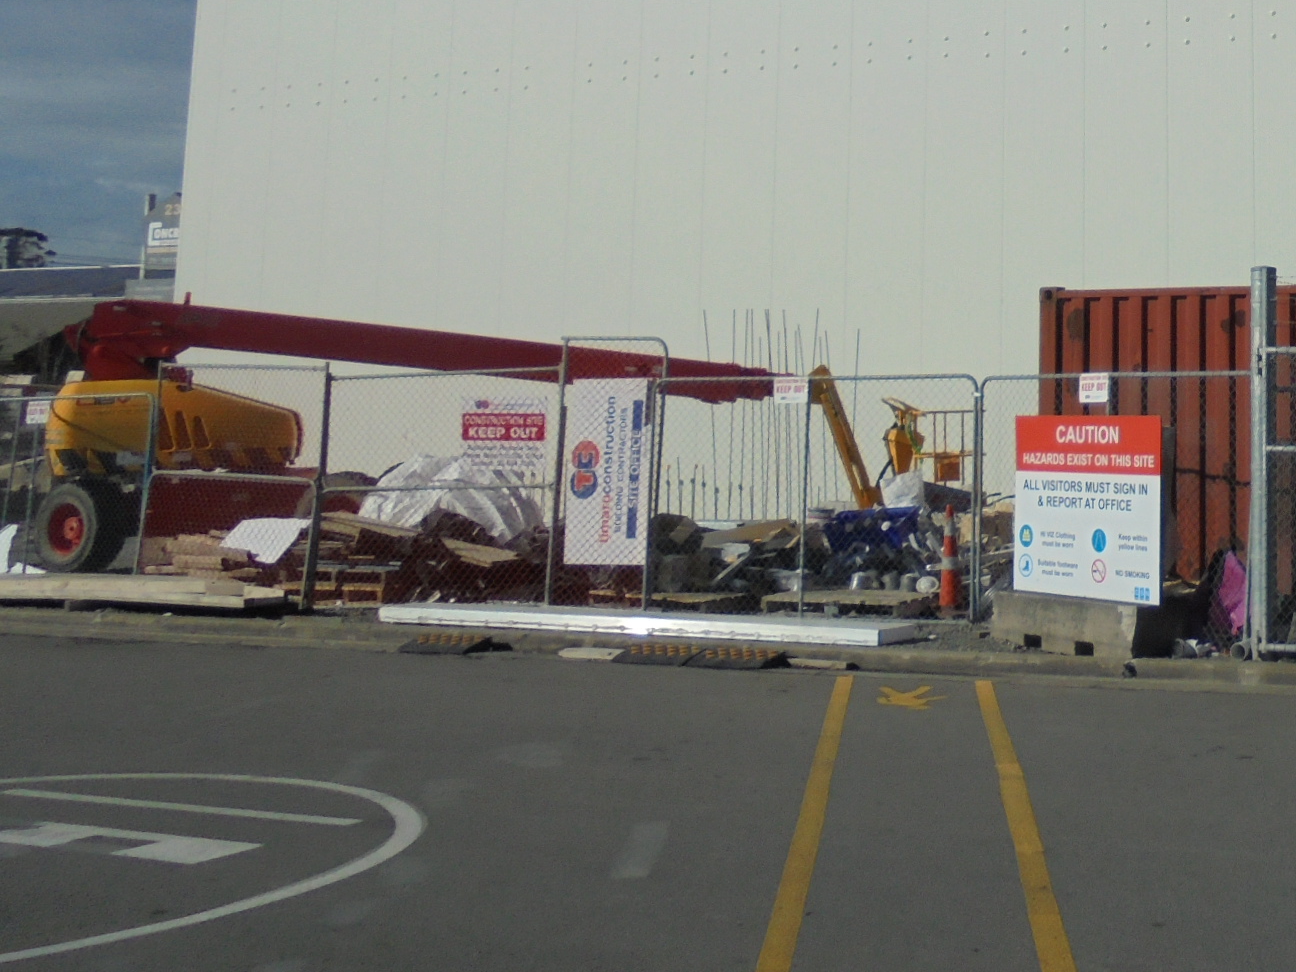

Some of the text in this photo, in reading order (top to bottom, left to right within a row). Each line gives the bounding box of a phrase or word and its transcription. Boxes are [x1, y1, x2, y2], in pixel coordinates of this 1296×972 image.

[468, 427, 538, 438] KEEP OUT
[1056, 425, 1119, 444] CAUTION
[617, 407, 628, 484] CONTRACTORS
[628, 429, 641, 508] SITE OFFICE
[1023, 453, 1155, 468] HAZARDS EXIST ON THIS SITE
[1023, 479, 1148, 495] ALL VISITORS MUST SIGN IN
[1037, 495, 1132, 511] & REPORT AT OFFICE
[1124, 571, 1150, 579] SMOKING
